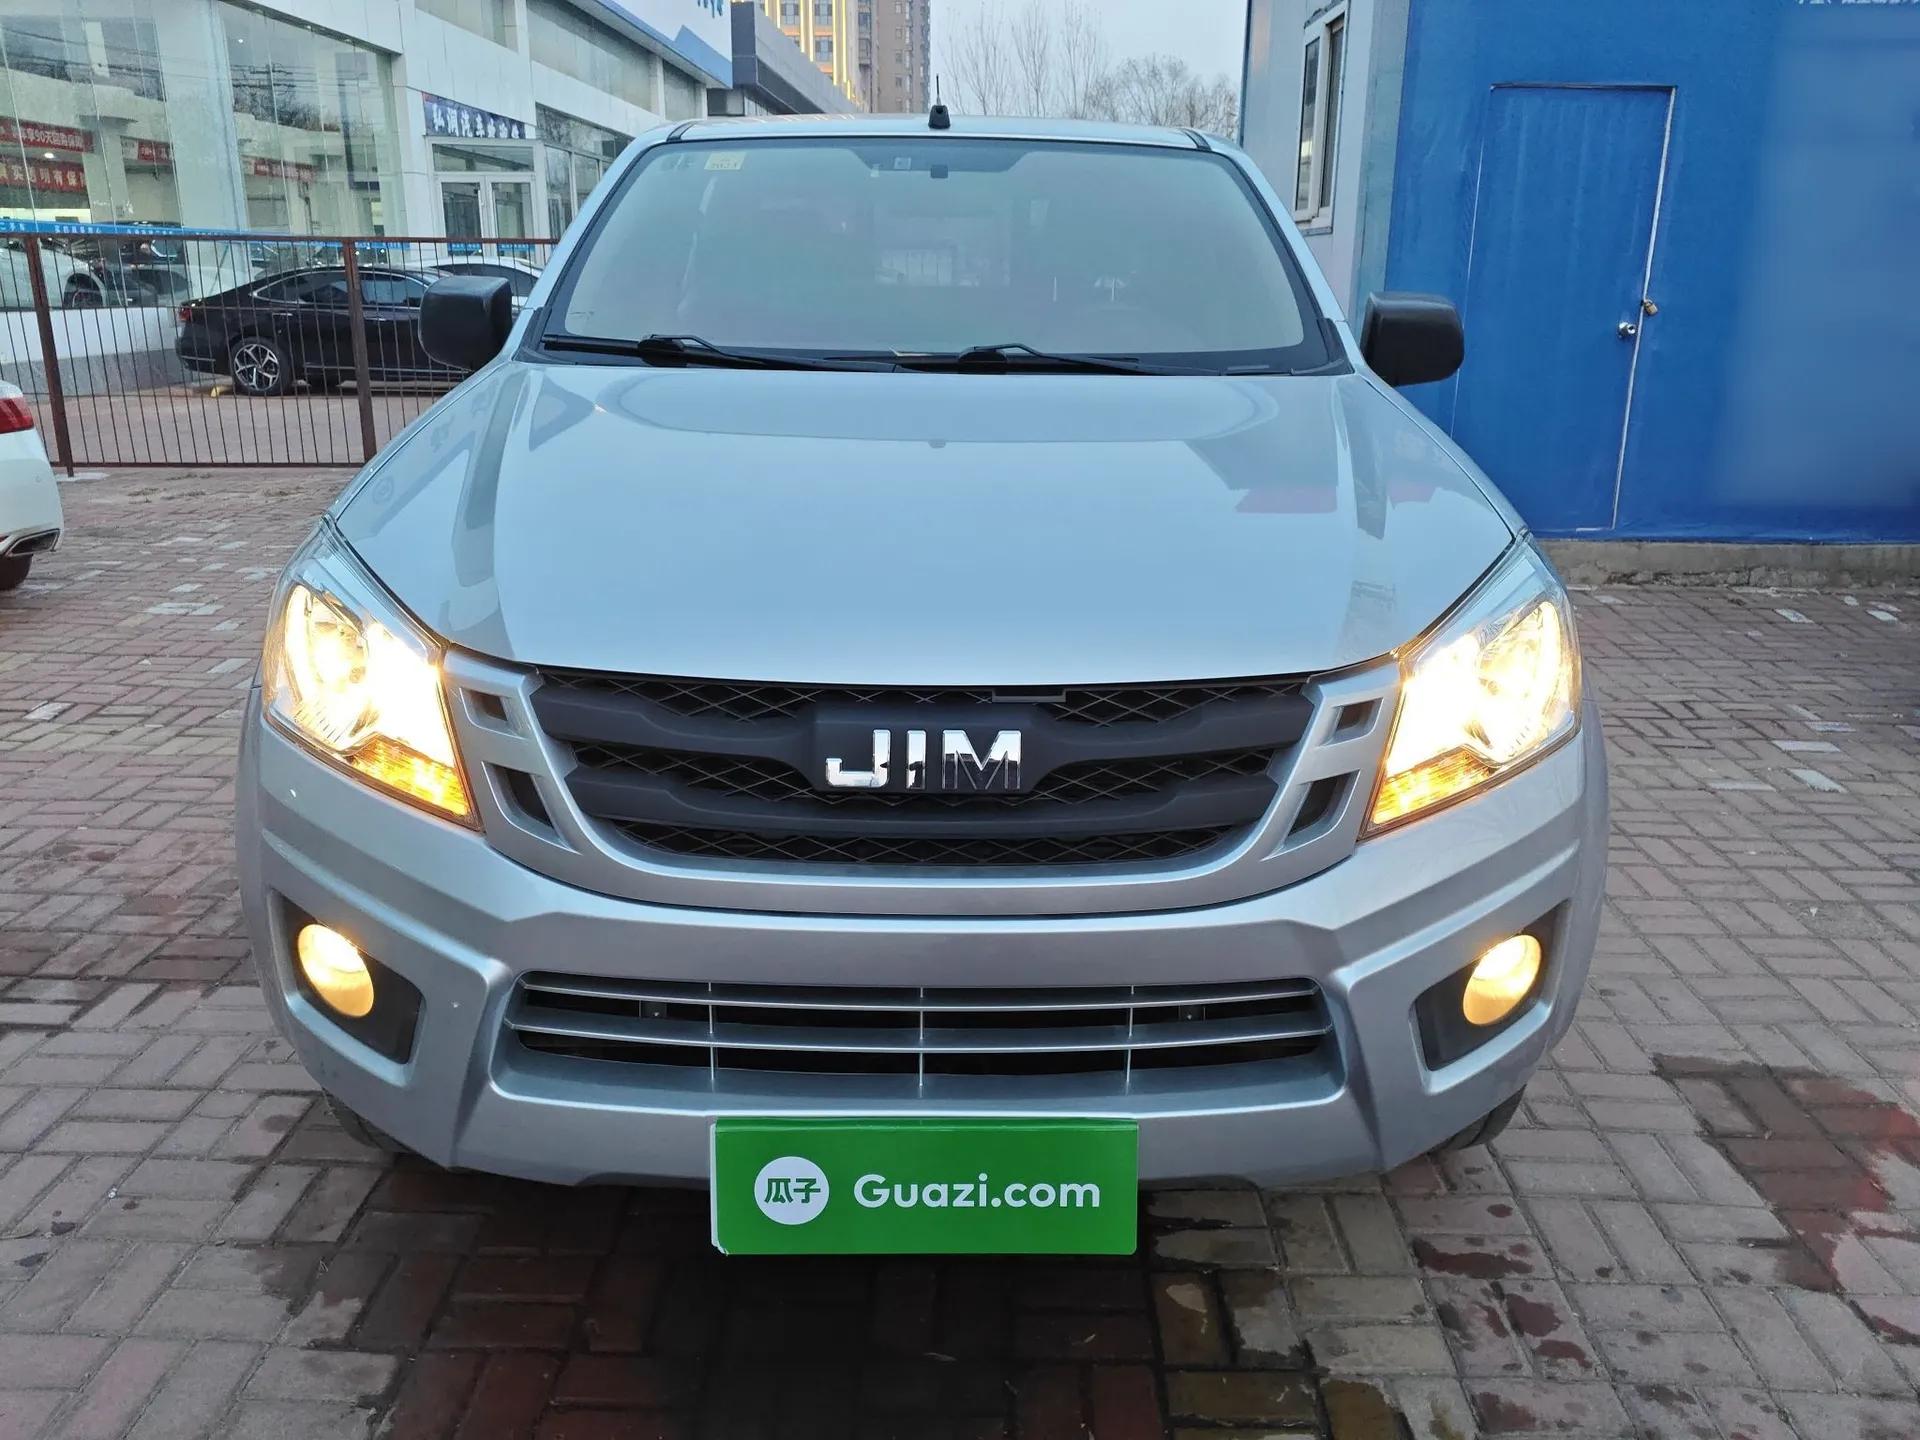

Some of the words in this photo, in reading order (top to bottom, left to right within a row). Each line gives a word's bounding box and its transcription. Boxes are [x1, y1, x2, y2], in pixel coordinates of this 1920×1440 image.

[826, 729, 1021, 789] JIM
[764, 1177, 821, 1204] 瓜子
[854, 1172, 1100, 1208] Guazi.com
